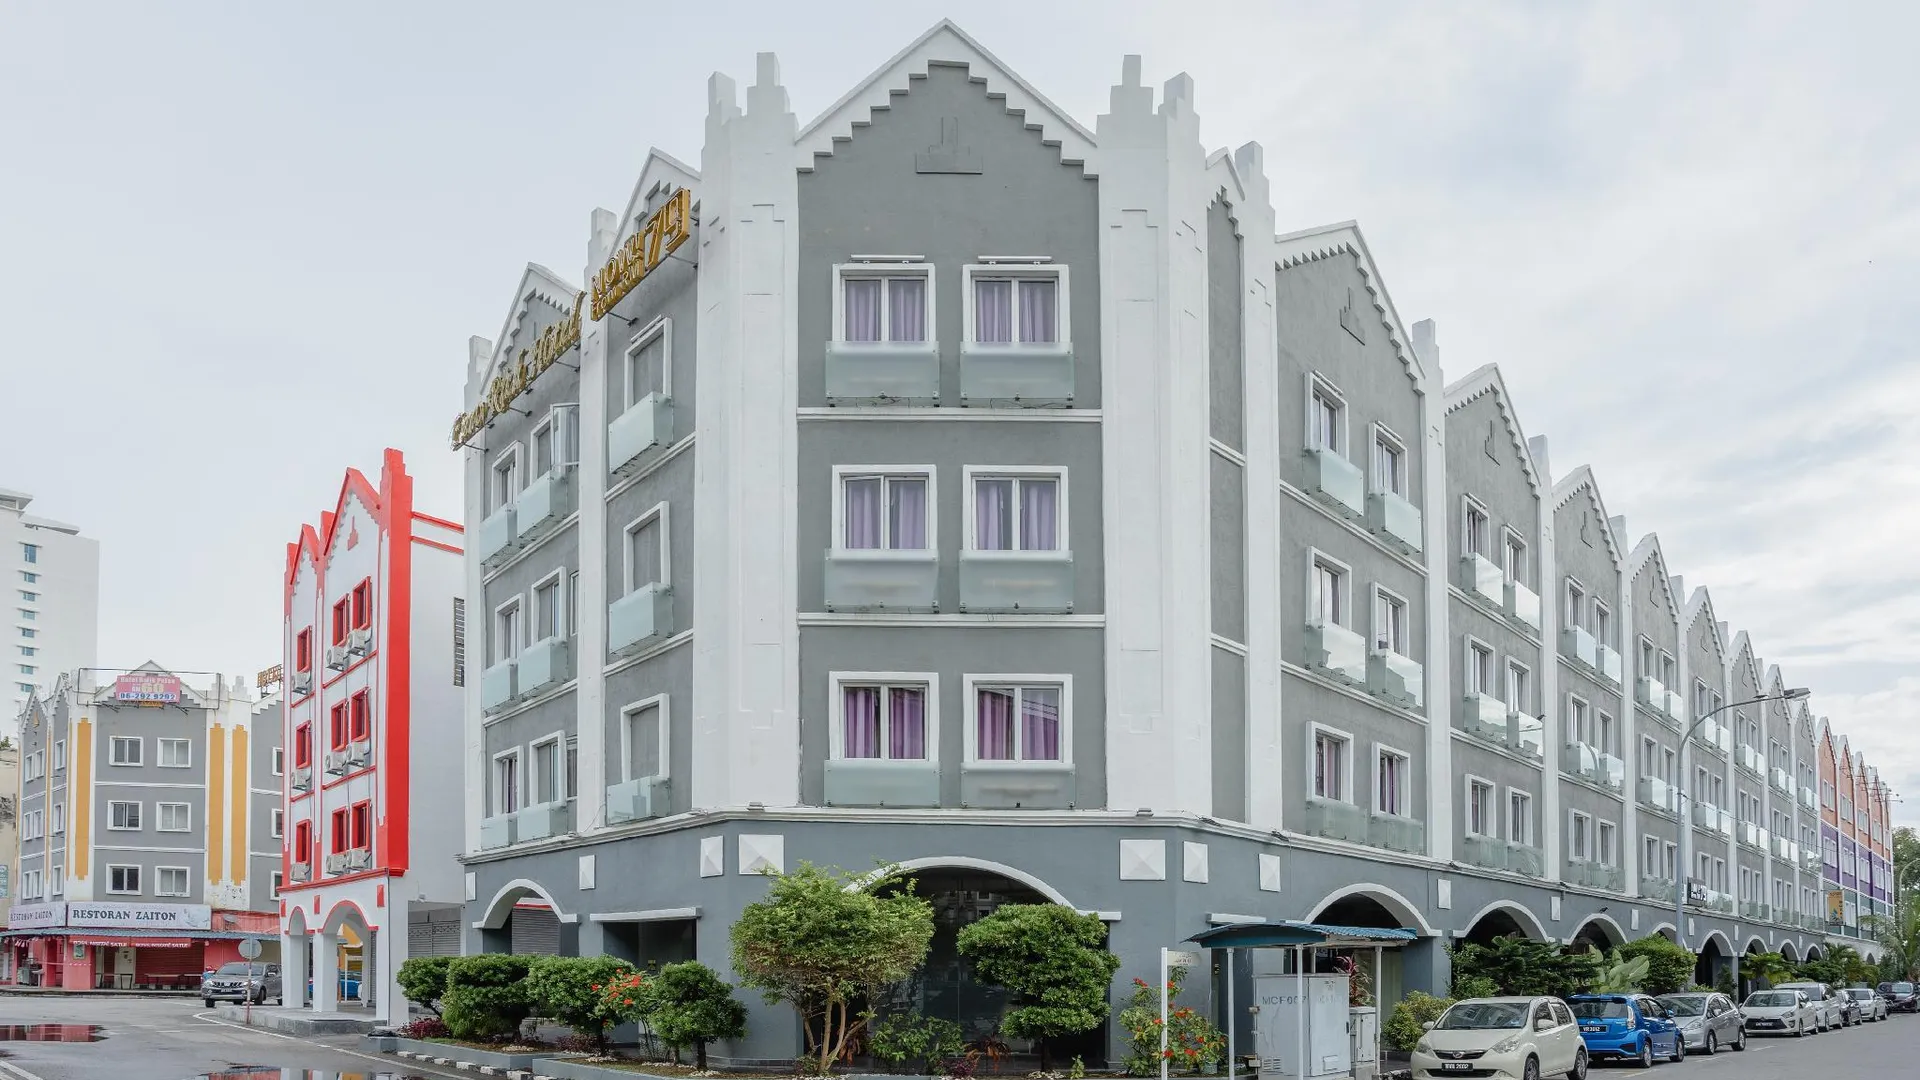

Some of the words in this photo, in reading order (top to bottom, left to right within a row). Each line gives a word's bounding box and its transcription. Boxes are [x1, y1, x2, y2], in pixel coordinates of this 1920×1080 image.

[645, 188, 691, 271] 79
[72, 909, 130, 920] RESTORAN
[135, 911, 176, 921] ZAITON
